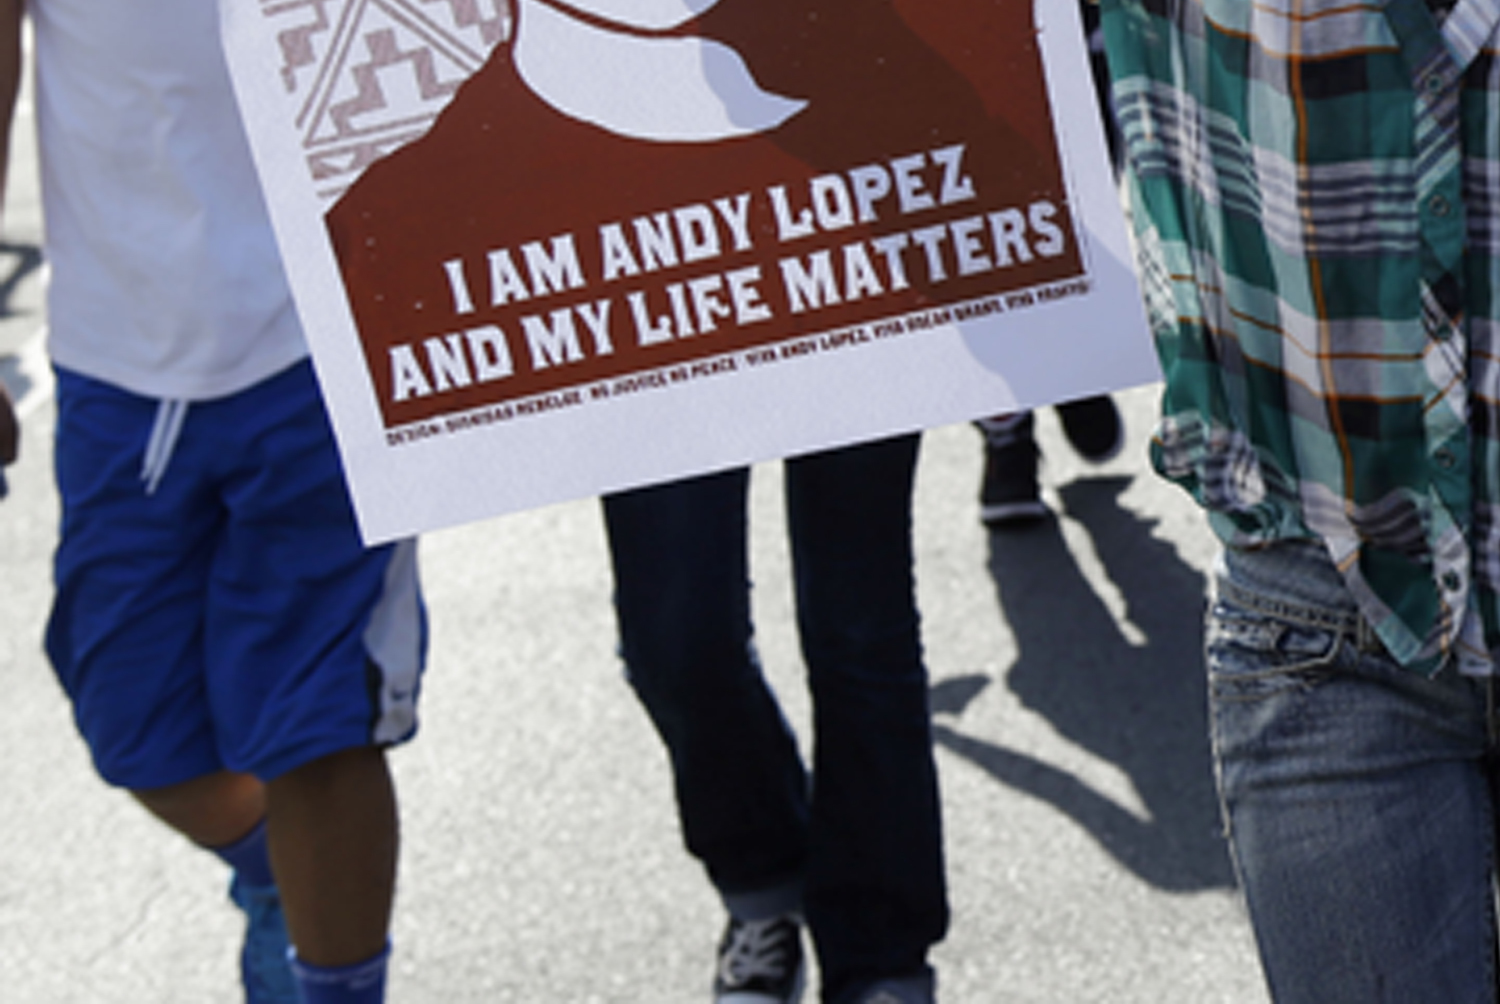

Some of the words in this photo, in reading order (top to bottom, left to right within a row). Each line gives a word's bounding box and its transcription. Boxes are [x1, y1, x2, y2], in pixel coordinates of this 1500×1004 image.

[389, 325, 514, 402] AND
[520, 299, 613, 370] MY
[628, 265, 773, 346] LIFE
[780, 202, 1064, 313] MATTERS
[444, 260, 474, 314] I
[487, 234, 586, 307] AM
[600, 193, 752, 281] ANDY
[768, 145, 975, 242] LOPEZ
